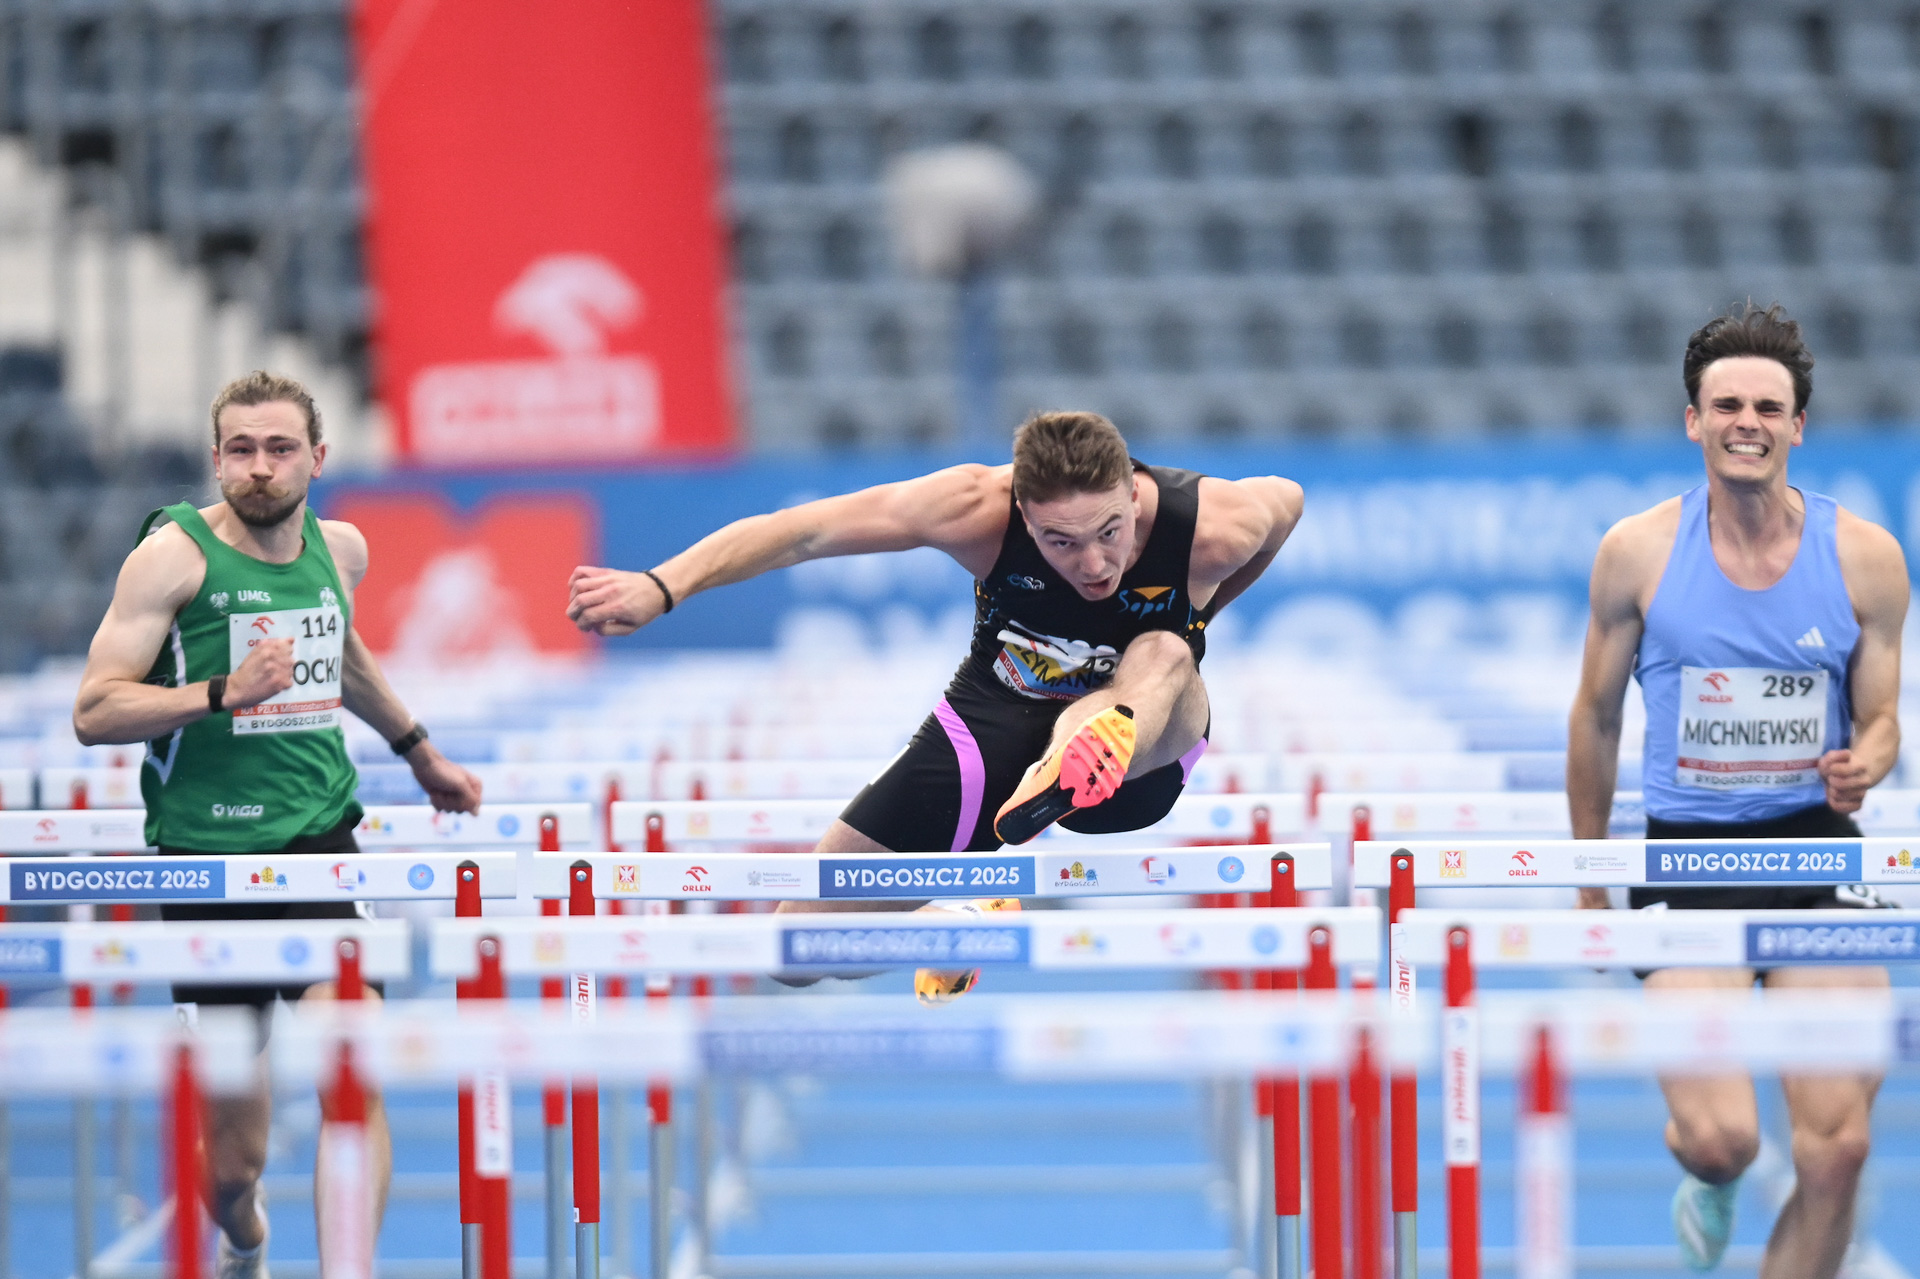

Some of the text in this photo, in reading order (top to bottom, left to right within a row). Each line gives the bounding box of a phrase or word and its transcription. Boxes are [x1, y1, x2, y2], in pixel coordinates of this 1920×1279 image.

[237, 590, 272, 602] UMCS
[1118, 588, 1176, 619] Sopot
[301, 613, 337, 638] 114
[292, 655, 341, 685] OCKI
[1762, 675, 1815, 698] 289
[250, 716, 316, 729] BYDGOSZCZ
[1683, 718, 1819, 745] MICHNIEWSKI
[1660, 852, 1847, 871] BYDGOSZCZ 2025
[25, 869, 211, 891] BYDGOSZCZ 2025
[834, 866, 1020, 888] BYDGOSZCZ 2025
[1508, 869, 1538, 877] ORLEN
[682, 884, 712, 892] ORLEN
